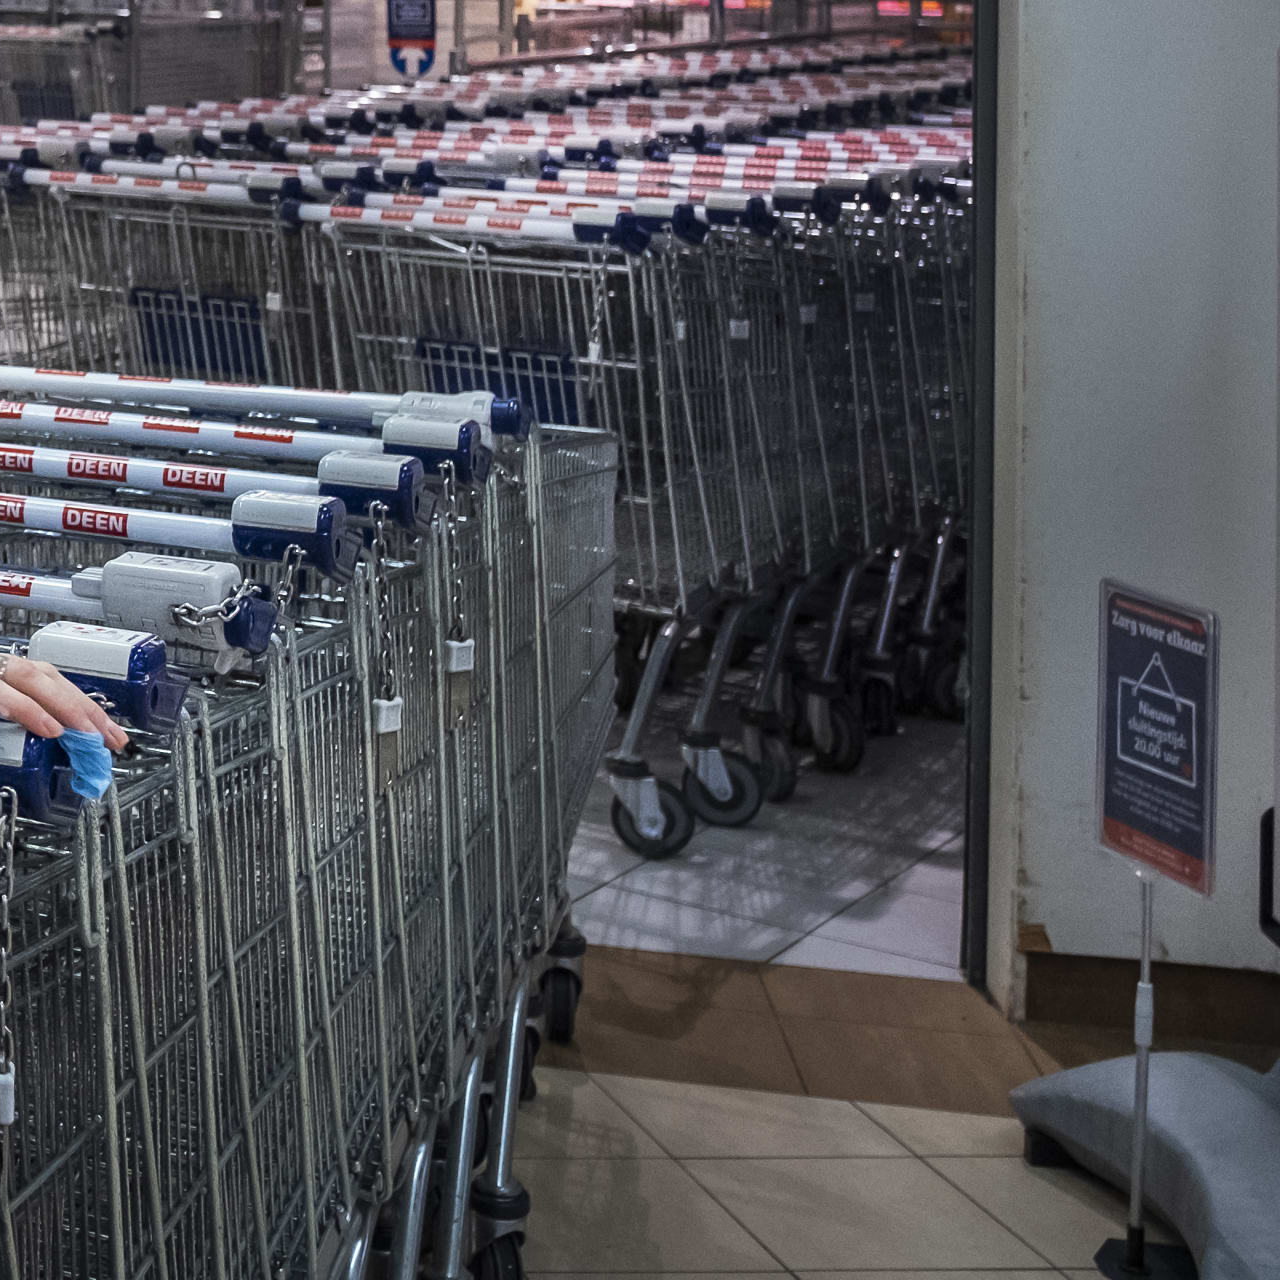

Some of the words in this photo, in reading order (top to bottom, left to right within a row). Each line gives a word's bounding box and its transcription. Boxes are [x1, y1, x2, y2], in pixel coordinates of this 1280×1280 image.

[72, 459, 123, 478] DEEN
[167, 470, 220, 487] DEEN
[66, 510, 123, 533] DEEN
[1112, 610, 1137, 637] Zorg
[1139, 623, 1165, 642] voor
[1139, 700, 1176, 727] Nieuwe
